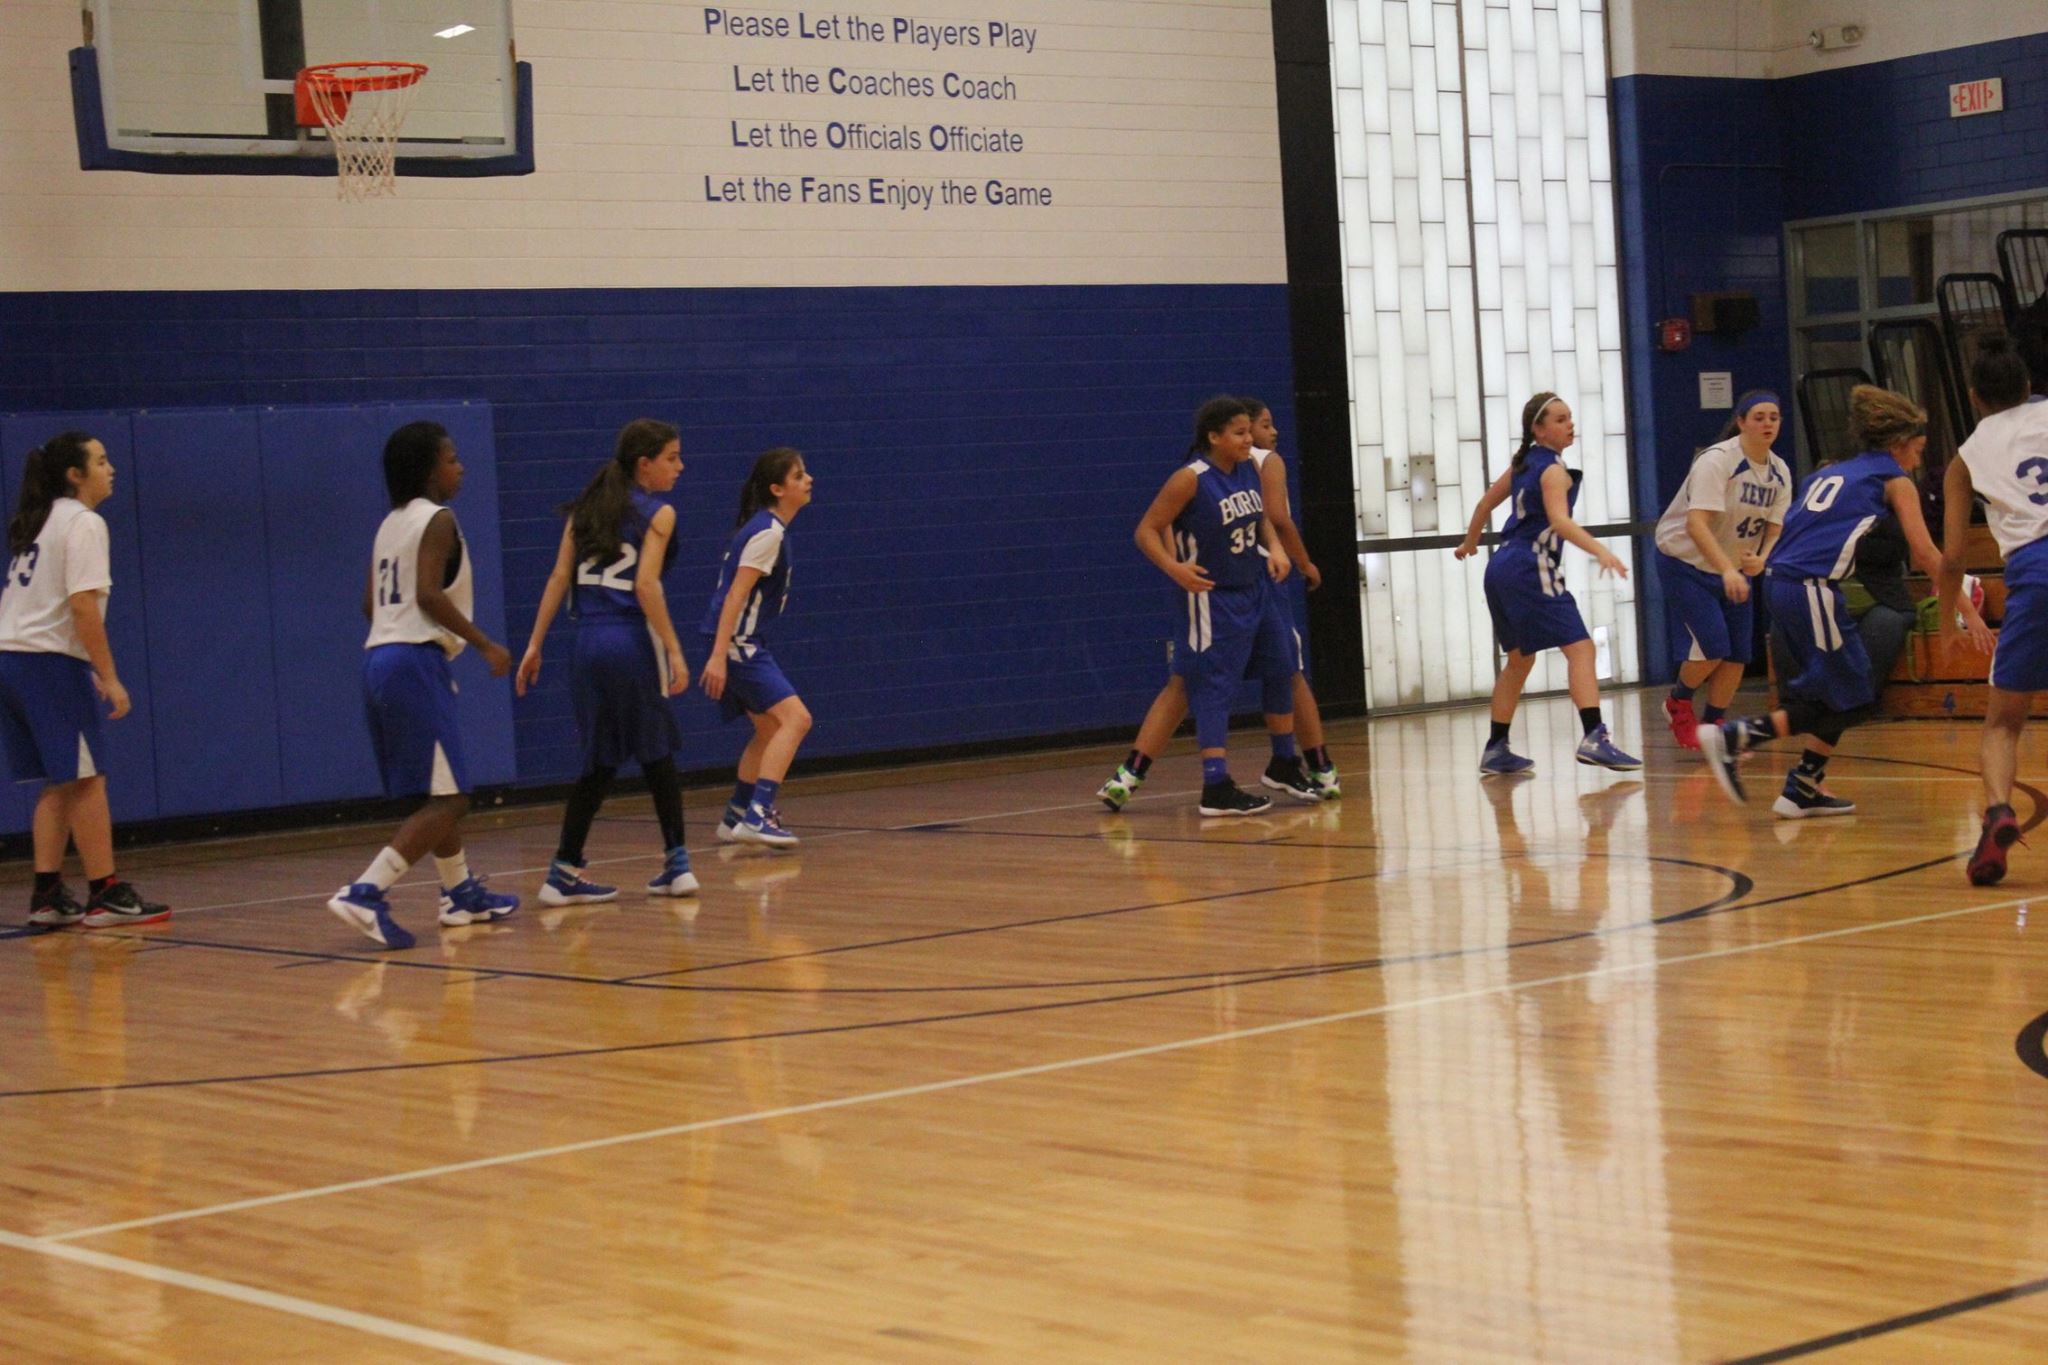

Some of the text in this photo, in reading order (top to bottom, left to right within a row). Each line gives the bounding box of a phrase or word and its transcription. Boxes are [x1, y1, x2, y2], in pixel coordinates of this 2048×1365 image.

[704, 8, 1037, 53] Please Let the Players Play
[734, 65, 1017, 100] Let the Coaches Coach
[731, 121, 1024, 152] Let the Officials Officiate
[705, 175, 1052, 210] Let the Fans Enjoy the Game
[1219, 489, 1263, 525] BORO
[1801, 475, 1845, 512] 10
[1230, 521, 1257, 555] 33
[1736, 516, 1765, 538] 43
[577, 542, 638, 592] 22
